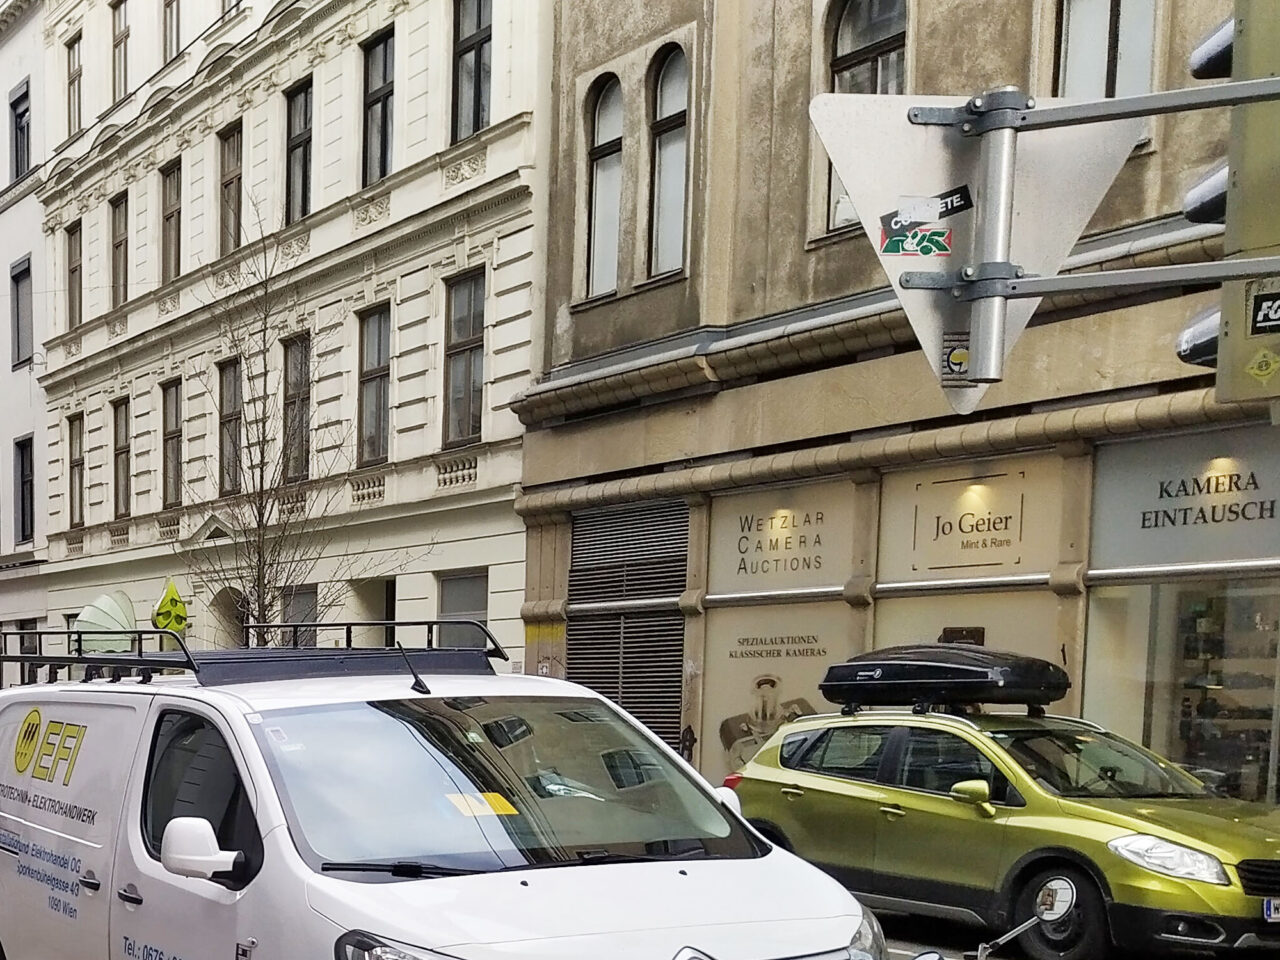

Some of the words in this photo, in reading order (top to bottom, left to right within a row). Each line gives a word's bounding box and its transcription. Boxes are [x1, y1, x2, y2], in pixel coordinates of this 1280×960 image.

[1158, 471, 1260, 499] KAMERA
[739, 511, 824, 533] WETZLAR
[933, 515, 953, 541] Jo
[958, 511, 1012, 534] Geier
[1141, 500, 1276, 529] EINTAUSCH
[737, 533, 822, 554] CAMERA
[961, 539, 979, 550] Mint
[981, 538, 987, 548] &
[990, 537, 1011, 548] Rare
[737, 555, 822, 575] AUCTIONS
[737, 634, 819, 647] SPEZIALAUKTIONEN
[729, 648, 782, 659] KLASSISCHER
[785, 647, 827, 658] KAMERAS
[32, 720, 88, 787] EFI
[32, 794, 98, 825] ELEKTROHANDWERK
[31, 843, 70, 871] Elektrohandel
[70, 857, 81, 874] OG
[62, 900, 78, 920] Wien
[123, 936, 140, 960] Tel.:
